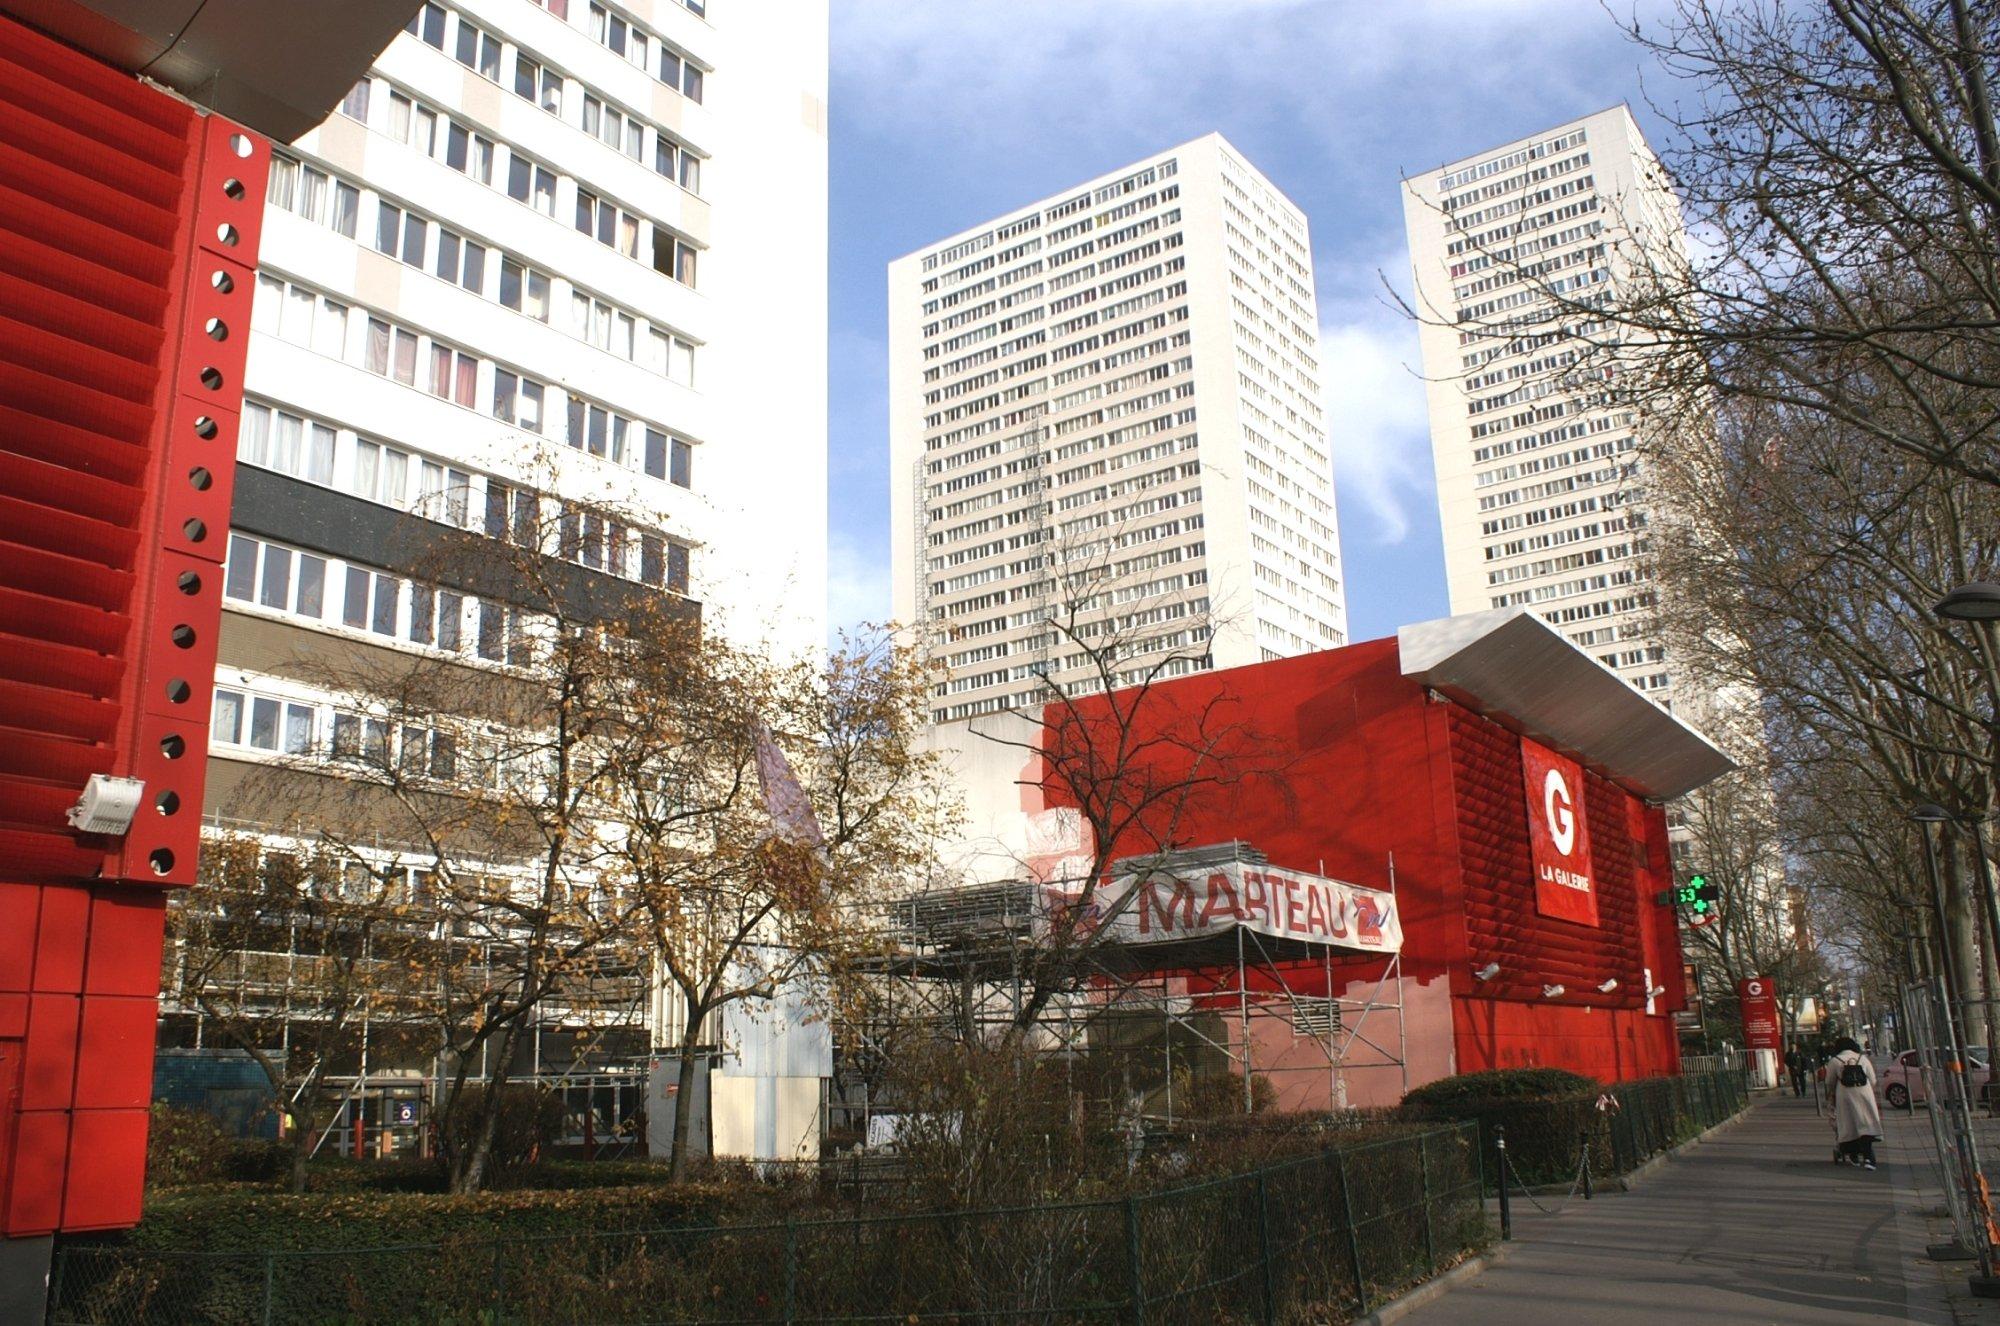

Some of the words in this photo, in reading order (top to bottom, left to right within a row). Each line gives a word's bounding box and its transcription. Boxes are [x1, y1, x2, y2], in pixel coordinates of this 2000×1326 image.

[1544, 768, 1574, 856] G
[1541, 863, 1554, 883] LA
[1554, 868, 1590, 893] GALERIE
[1138, 871, 1348, 938] MARTEAU
[1747, 981, 1763, 996] G
